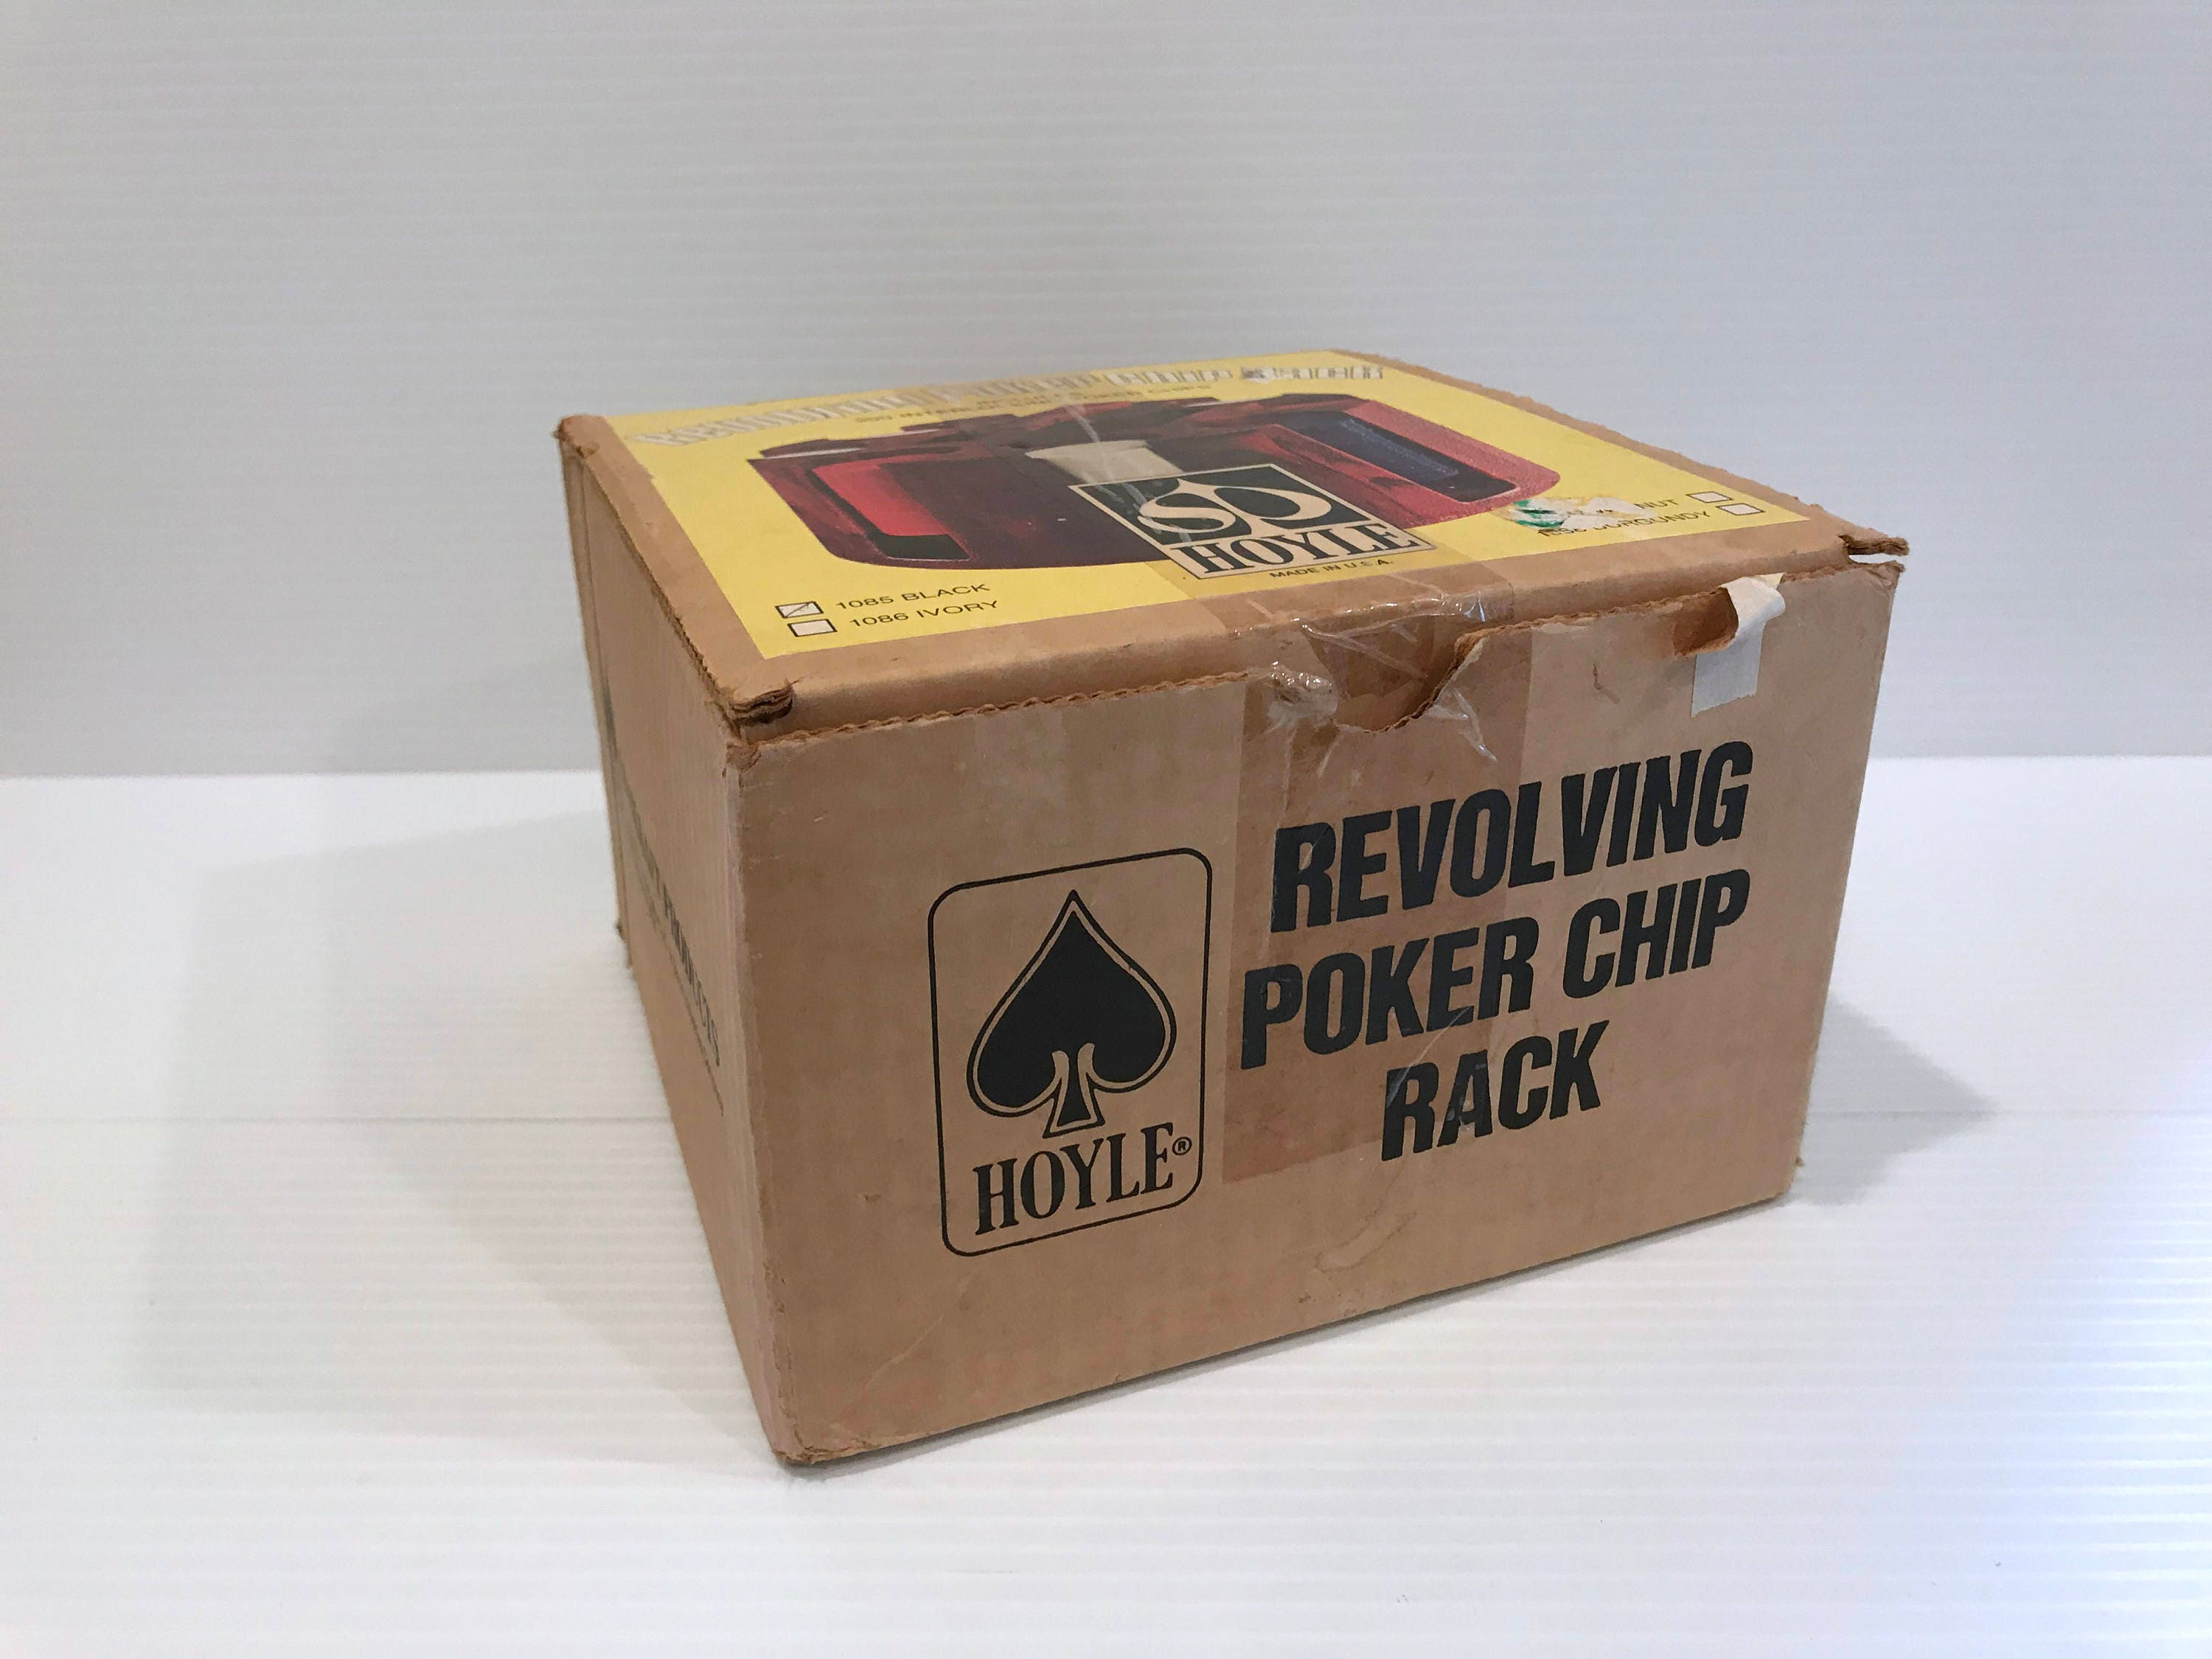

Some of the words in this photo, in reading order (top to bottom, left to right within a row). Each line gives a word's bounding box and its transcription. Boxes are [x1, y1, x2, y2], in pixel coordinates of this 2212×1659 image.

[1169, 523, 1418, 574] HOYLE
[1269, 567, 1321, 578] MADE
[1322, 564, 1342, 572] IN
[836, 596, 894, 610] 1085
[901, 583, 991, 602] BLACK
[849, 613, 909, 627] 1086
[917, 600, 998, 618] IVORY
[1270, 740, 1753, 933] REVOLVING
[1240, 916, 1540, 1071] POKER
[1562, 868, 1751, 999] CHIP
[1381, 1019, 1610, 1162] RACK
